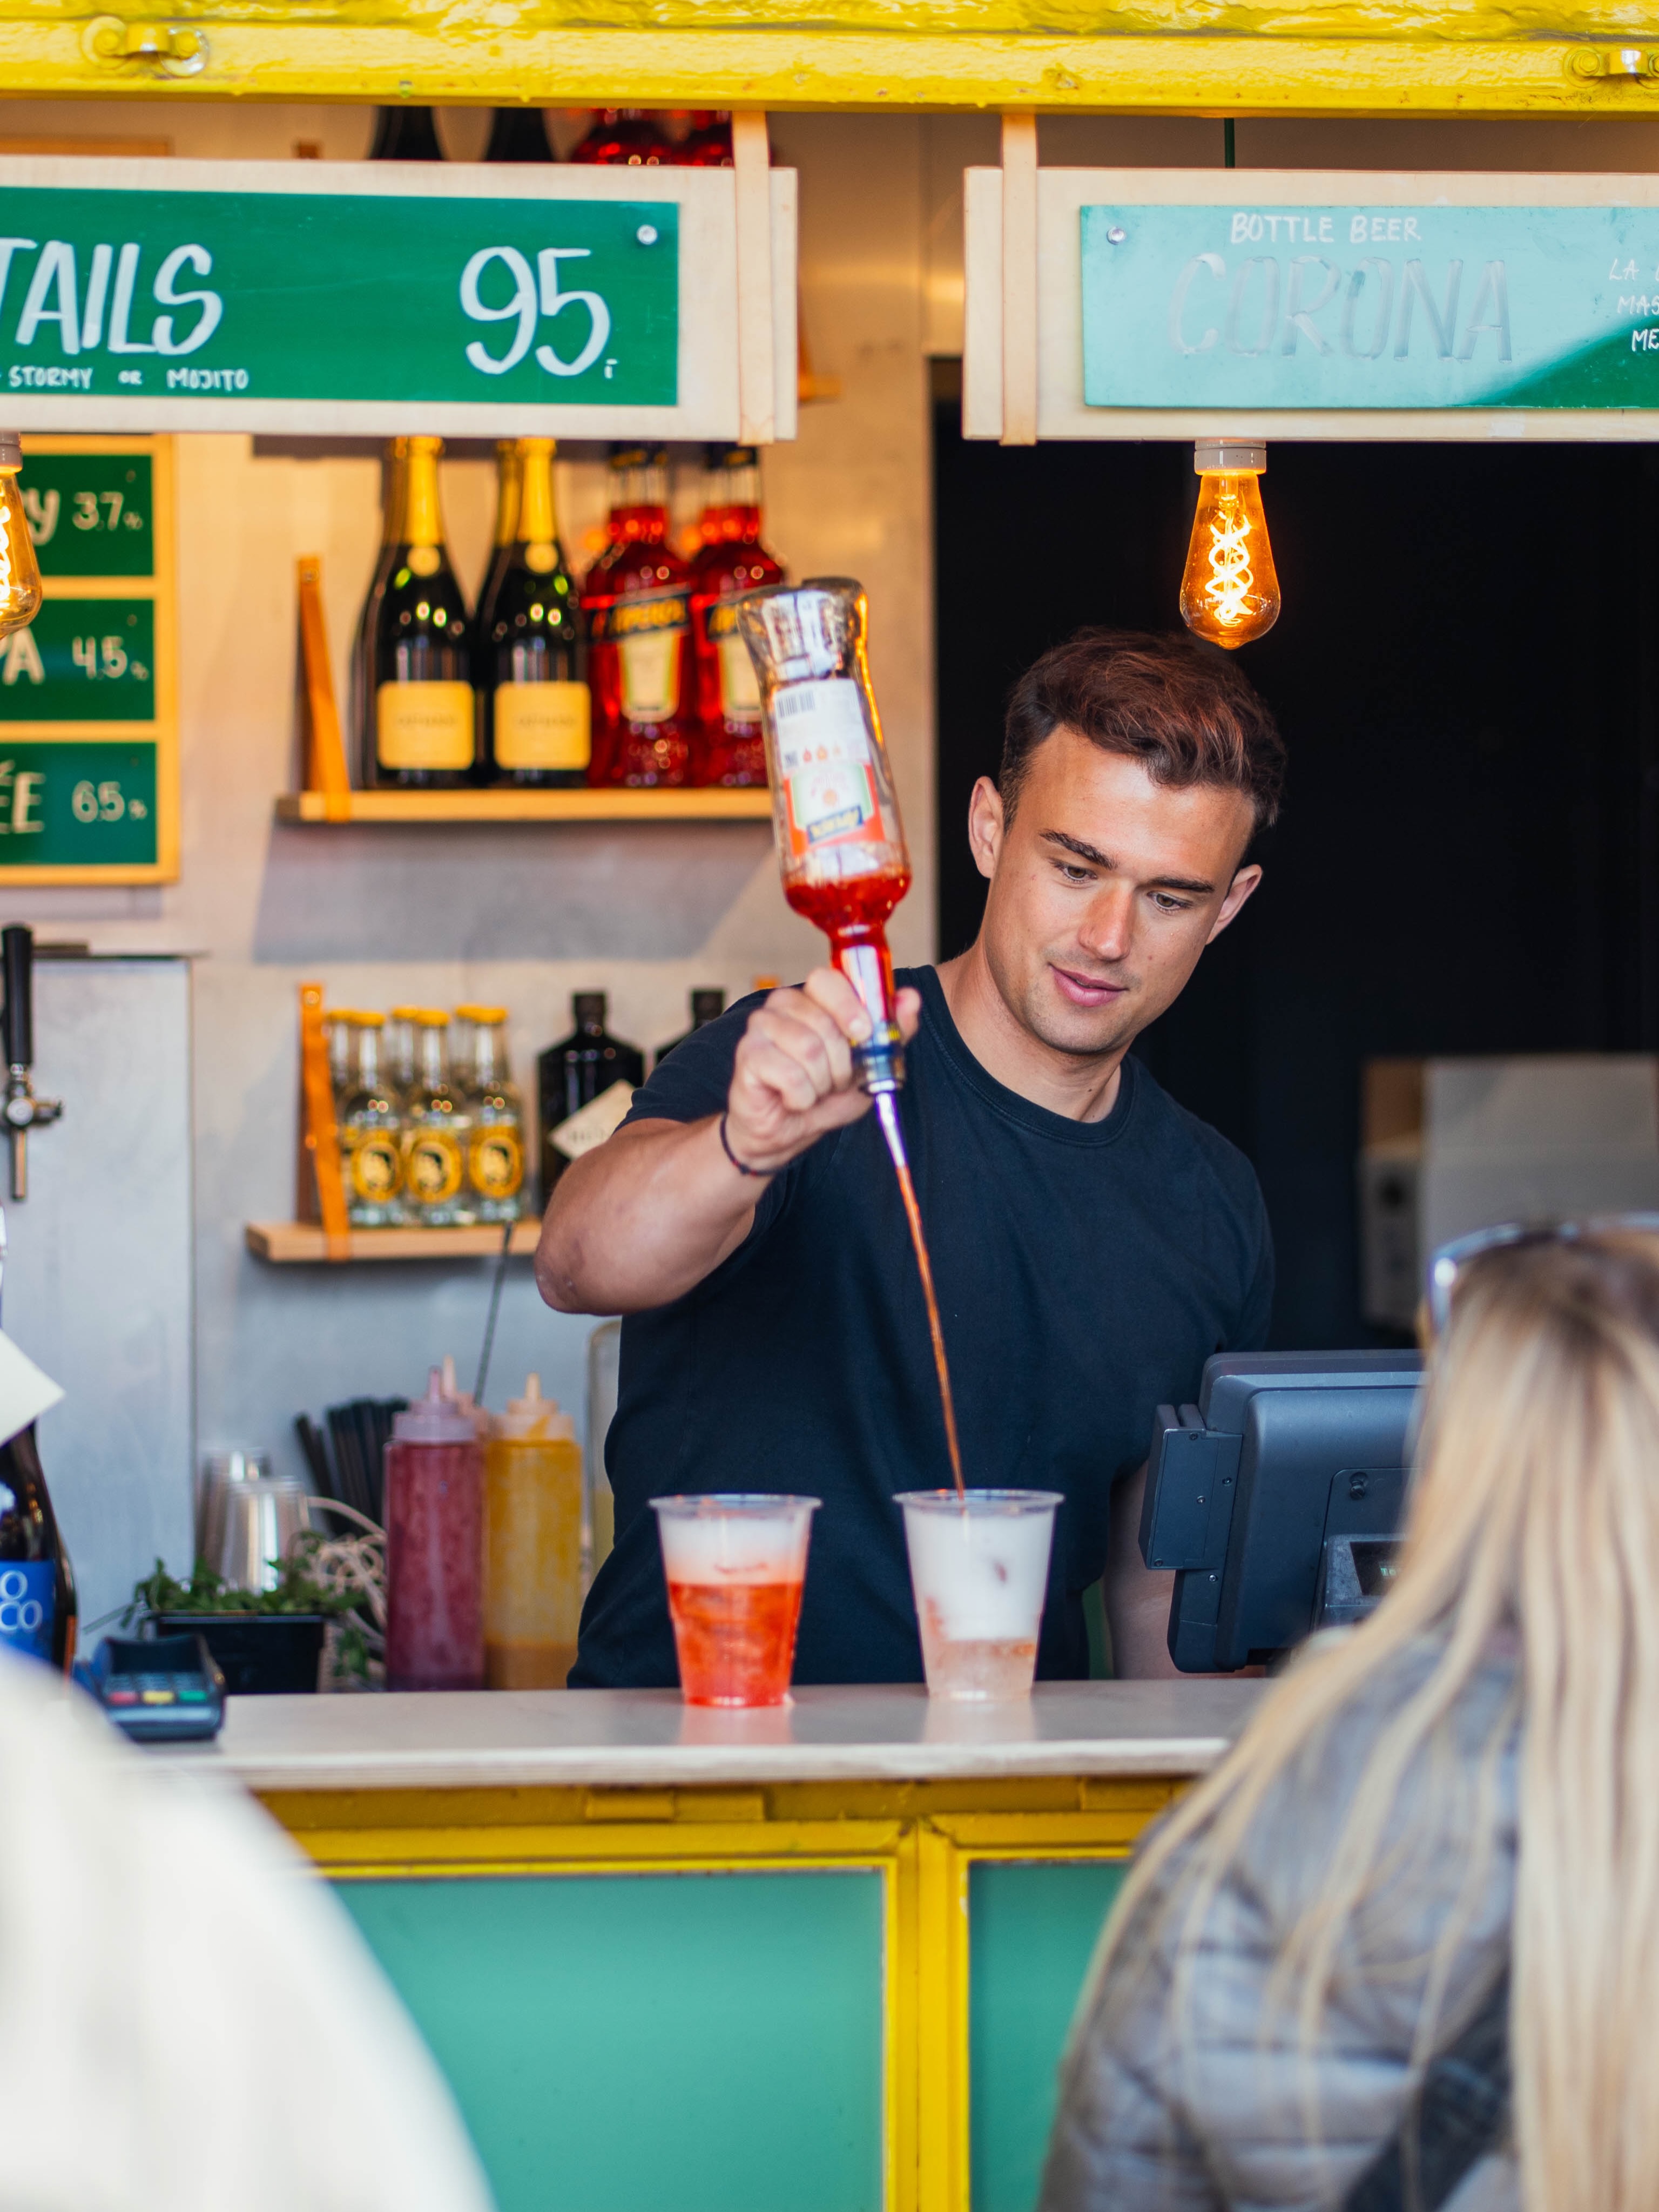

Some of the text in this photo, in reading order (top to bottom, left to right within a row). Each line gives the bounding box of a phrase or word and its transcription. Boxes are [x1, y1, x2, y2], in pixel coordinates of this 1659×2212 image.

[1231, 212, 1421, 244] BOTTLE BEER
[1609, 258, 1640, 281] LA
[1167, 252, 1512, 363] CORONA
[8, 365, 249, 392] STORMY OR MOJITO
